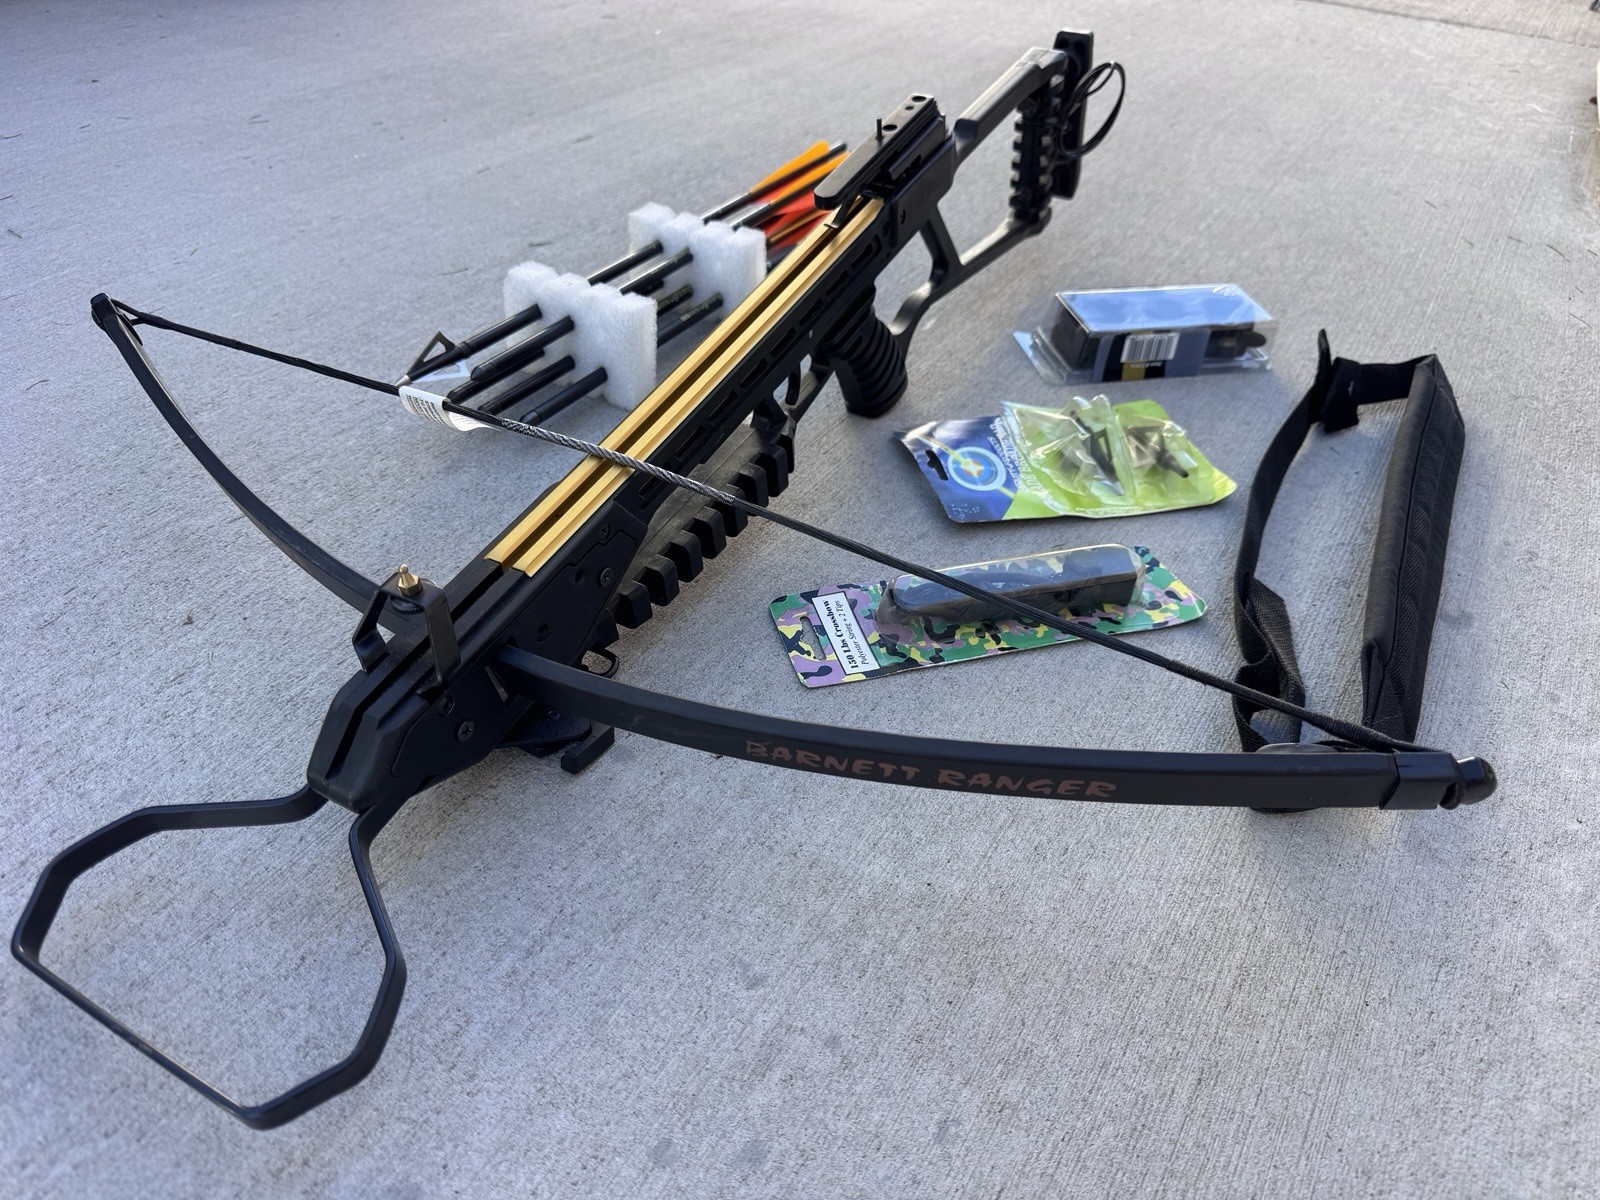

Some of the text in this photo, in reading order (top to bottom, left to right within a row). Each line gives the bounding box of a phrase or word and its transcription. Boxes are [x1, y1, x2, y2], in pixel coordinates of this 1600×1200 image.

[834, 600, 844, 612] Tips
[822, 599, 859, 669] 150 Lbs Crossbow
[844, 622, 857, 640] String
[853, 640, 870, 665] Polyester
[744, 739, 1118, 799] BARNETT RANGER
